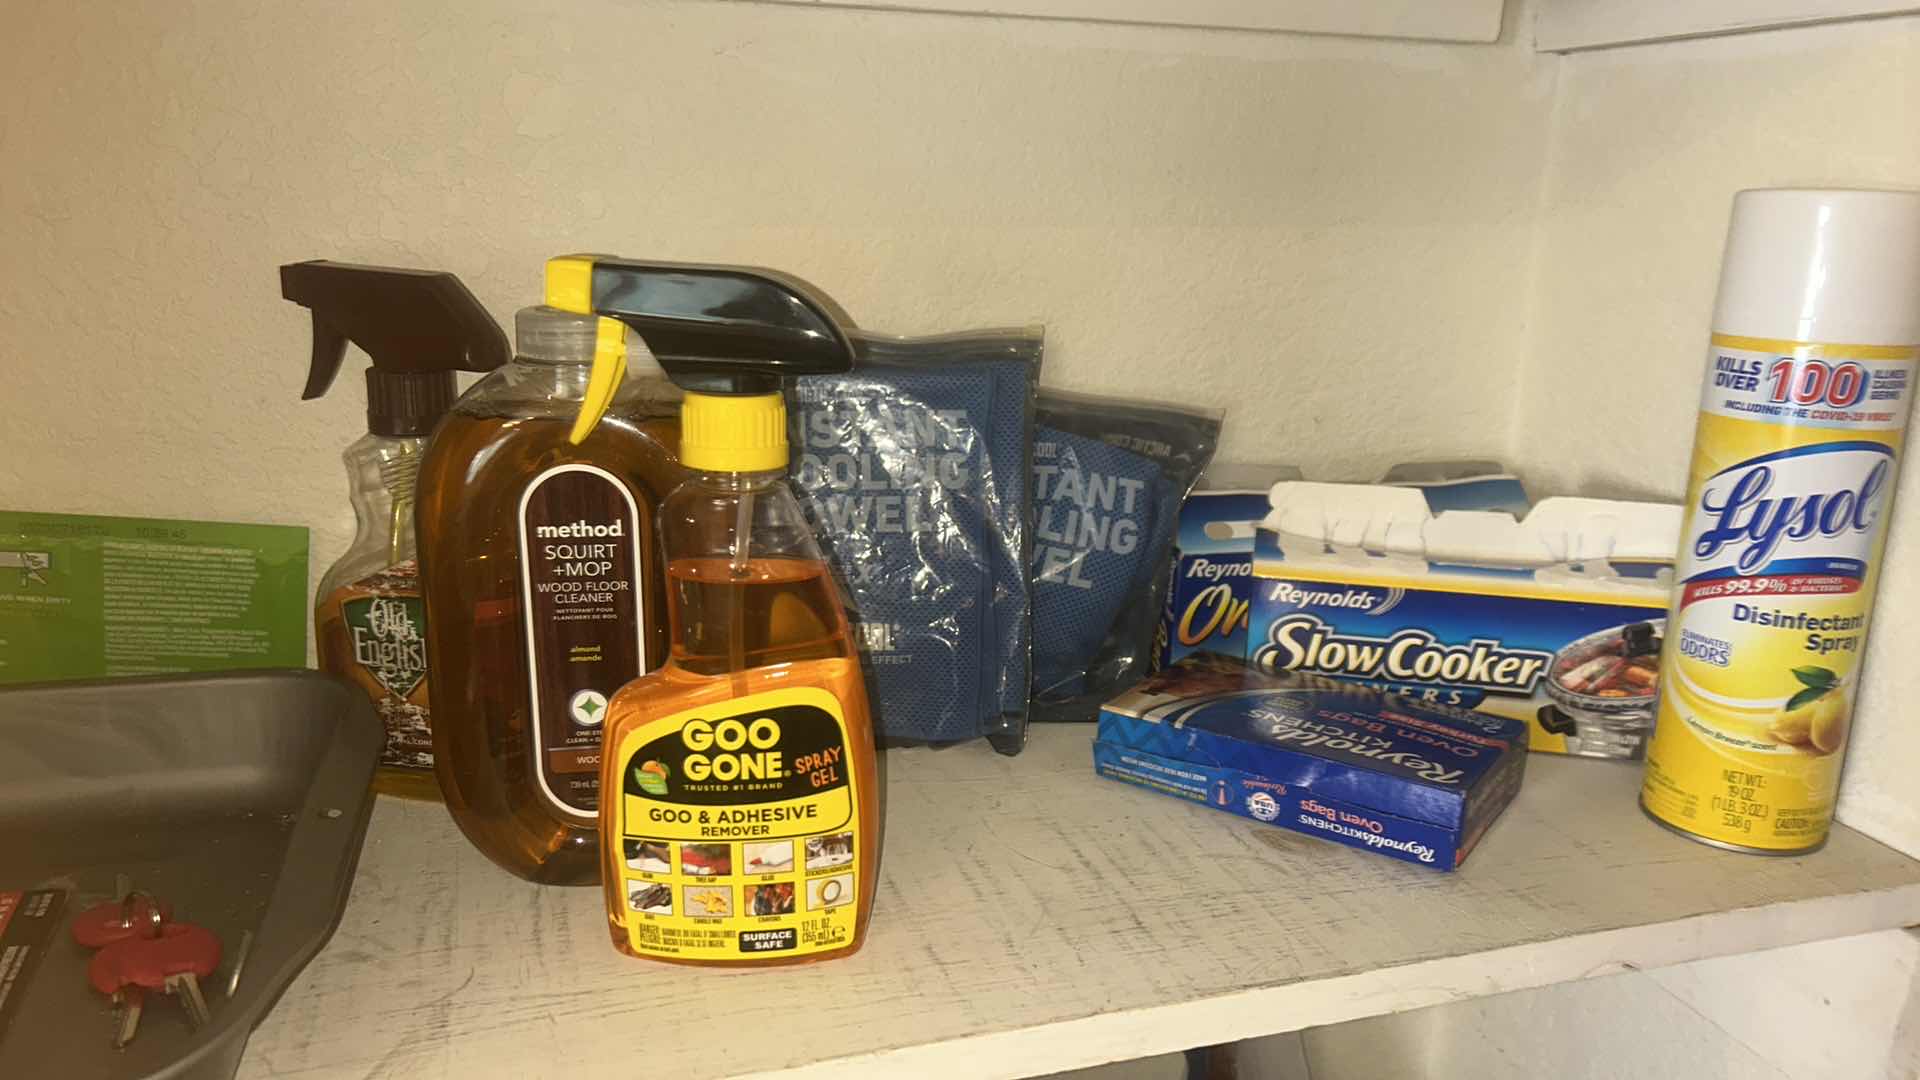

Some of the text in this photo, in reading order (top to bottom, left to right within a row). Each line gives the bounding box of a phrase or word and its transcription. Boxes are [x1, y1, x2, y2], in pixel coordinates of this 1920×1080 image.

[1716, 356, 1762, 376] KILLS
[1715, 373, 1759, 392] OVER
[1769, 358, 1867, 408] 100
[1724, 400, 1783, 417] INCLUDING
[1784, 408, 1809, 418] THE
[797, 408, 969, 449] STANT
[799, 452, 969, 490] OOLING
[1033, 464, 1145, 515] TANT
[1695, 458, 1888, 571] Lysol
[537, 518, 623, 538] method
[1038, 505, 1138, 555] LING
[545, 543, 618, 560] SQUIRT
[552, 561, 612, 577] +MOP
[1185, 559, 1251, 581] Reyno
[537, 580, 629, 593] WOOD FLOOR
[1270, 583, 1376, 610] Reynolds
[1694, 578, 1788, 597] KILLS 99.9%
[555, 592, 614, 604] CLEANER
[570, 645, 601, 653] almond
[1682, 629, 1729, 650] ELIMINATES
[353, 627, 428, 678] Englis
[570, 654, 603, 662] amande
[1262, 621, 1543, 686] Slow Cooker
[1680, 637, 1729, 665] ODORS
[1248, 708, 1392, 750] KITCHENS
[1318, 709, 1386, 734] Bags
[682, 719, 781, 751] GOO
[1396, 730, 1480, 758] Oven
[795, 746, 841, 775] SPRAY
[1271, 725, 1465, 785] Reynolds
[683, 752, 783, 781] GONE
[1724, 769, 1746, 784] NET
[684, 782, 784, 792] TRUSTED #1 BRAND
[810, 770, 839, 788] GEL
[649, 804, 818, 824] GOO & ADHESIVE
[1300, 799, 1337, 822] Bags
[1722, 812, 1744, 827] 538
[701, 825, 770, 837] REMOVER
[1340, 811, 1384, 834] Oven
[742, 930, 793, 942] SURFACE
[754, 940, 784, 950] SAFE
